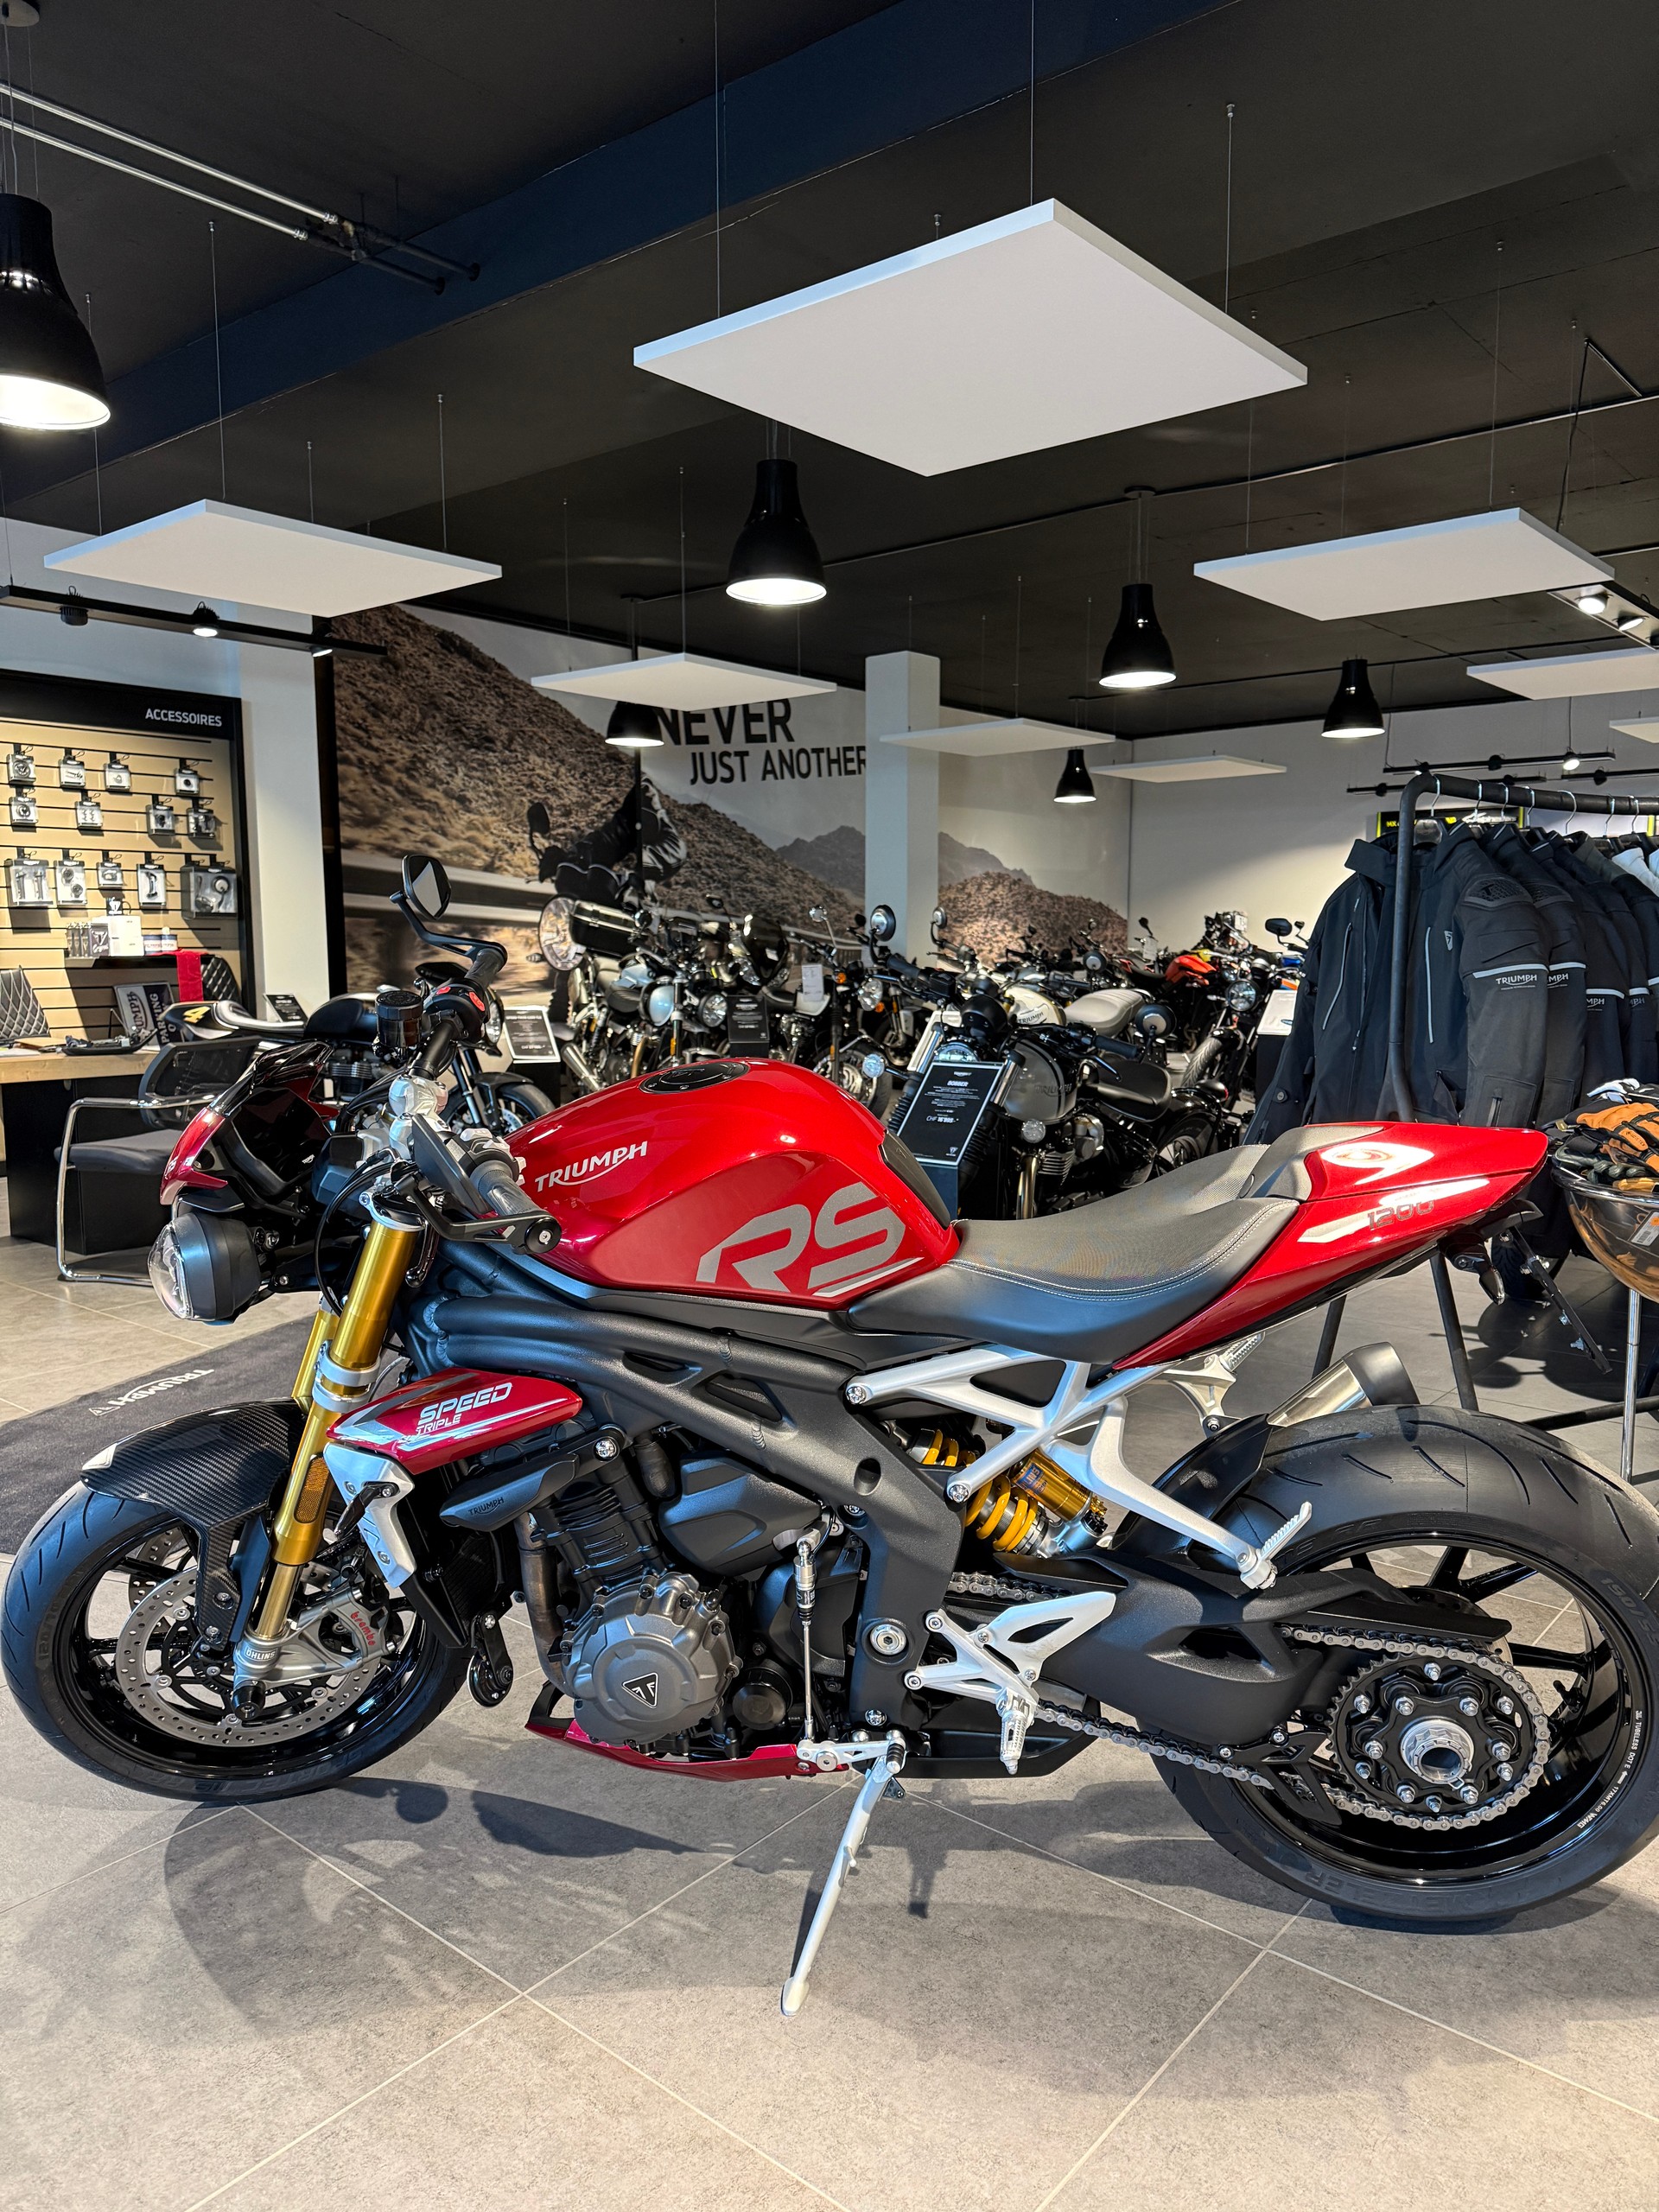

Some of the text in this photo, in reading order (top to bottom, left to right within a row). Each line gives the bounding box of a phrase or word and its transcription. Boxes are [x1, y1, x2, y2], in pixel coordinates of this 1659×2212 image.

[145, 708, 222, 727] ACCESSOIRES
[654, 699, 795, 746] NEVER
[690, 749, 750, 785] JUST
[1496, 974, 1537, 986] TRIUMPH
[1548, 973, 1568, 986] MPH
[126, 991, 147, 1031] UMPH
[149, 993, 170, 1044] PARING
[182, 1006, 211, 1024] 4
[1017, 1011, 1044, 1025] TRIUMPH
[534, 1141, 648, 1193] TRIUMPH
[1368, 1199, 1434, 1231] 1200
[695, 1180, 906, 1294] RS
[107, 1369, 215, 1407] TRIUMPH
[417, 1382, 512, 1427] SPEED
[415, 1413, 462, 1436] TRIPLE
[467, 1496, 505, 1516] TRIUMPH
[350, 1611, 376, 1647] brembo
[1630, 1721, 1643, 1751] TUBELESS
